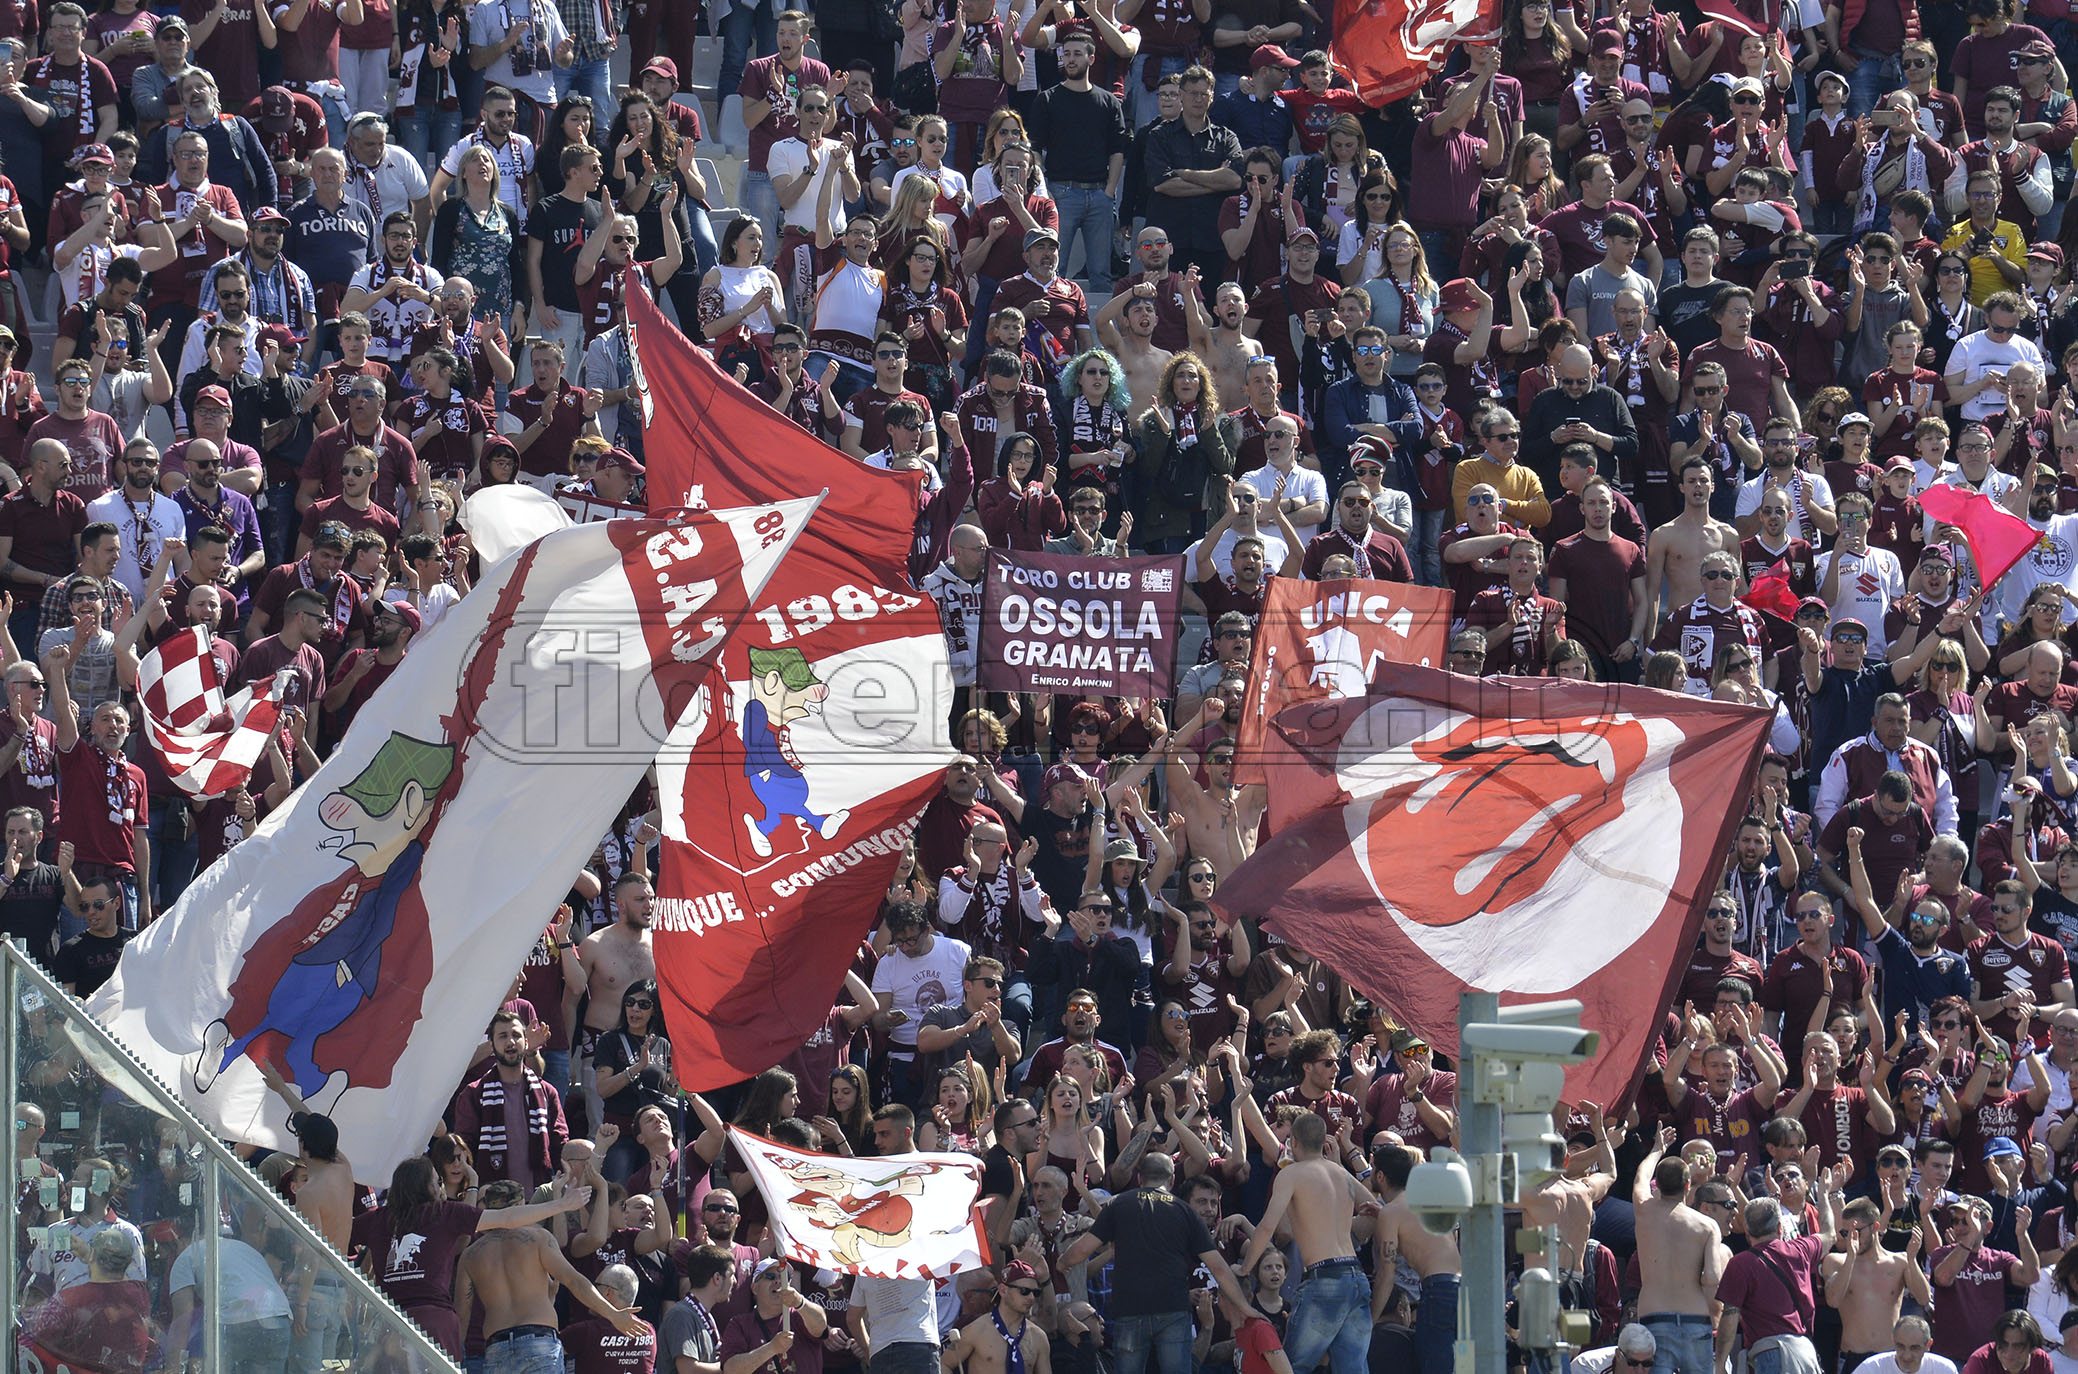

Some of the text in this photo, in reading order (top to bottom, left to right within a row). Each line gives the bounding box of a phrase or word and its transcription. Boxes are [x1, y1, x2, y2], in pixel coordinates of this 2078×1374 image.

[1927, 101, 1944, 110] 1906
[299, 219, 369, 237] TORINO
[554, 228, 594, 244] SUPE
[971, 415, 998, 433] TORI
[65, 472, 109, 489] ORIN
[997, 564, 1131, 590] TORO CLUB
[999, 595, 1163, 640] OSSOLA
[1300, 591, 1413, 639] UNICA
[1003, 640, 1156, 673] GRANATA
[770, 801, 930, 898] COMUNQ
[912, 969, 941, 983] ULTRAS
[1189, 1006, 1218, 1015] SUZUKI
